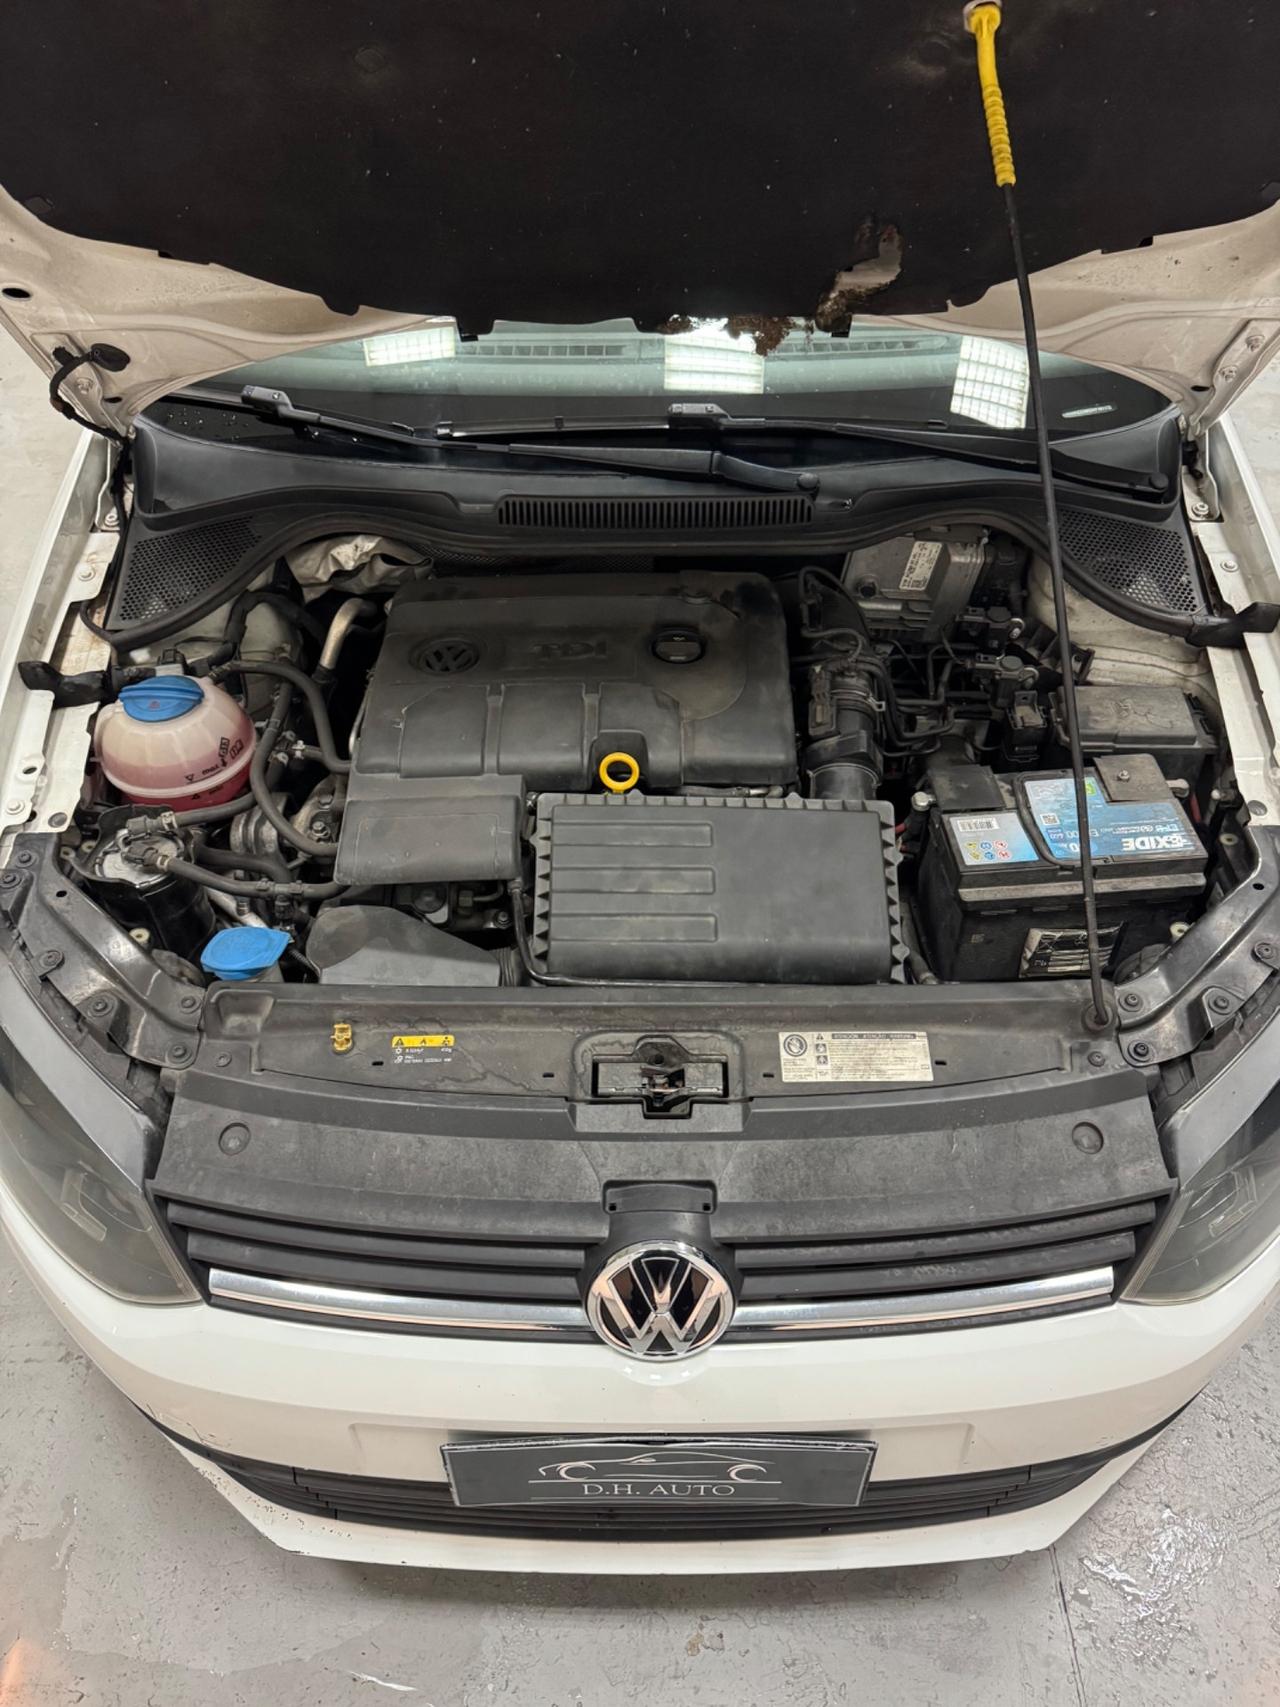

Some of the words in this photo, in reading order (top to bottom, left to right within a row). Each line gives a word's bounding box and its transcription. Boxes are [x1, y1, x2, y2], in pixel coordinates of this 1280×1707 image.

[532, 640, 608, 660] TDI
[1121, 835, 1184, 852] EXIDE
[582, 1483, 641, 1496] D.H.
[648, 1483, 736, 1497] AUTO
